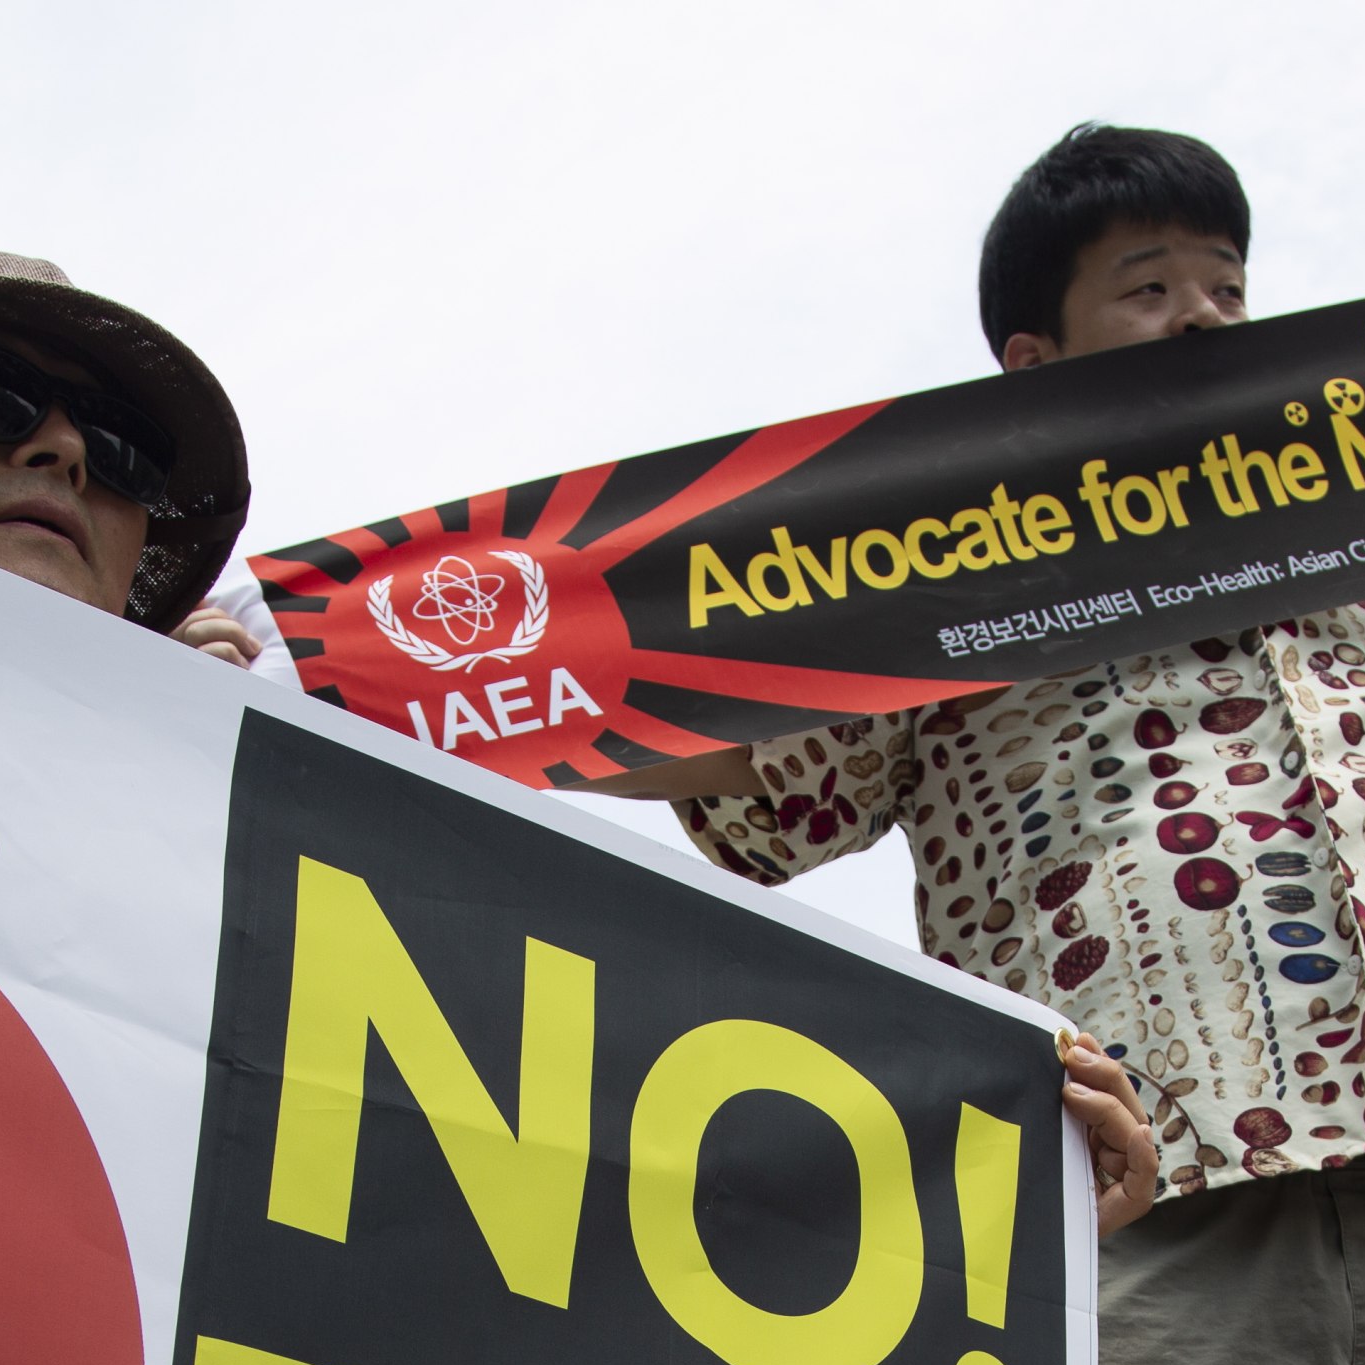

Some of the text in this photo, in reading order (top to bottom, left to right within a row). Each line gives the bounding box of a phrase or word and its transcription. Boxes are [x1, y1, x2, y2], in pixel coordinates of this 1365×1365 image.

[687, 482, 1075, 629] Advocate
[1078, 459, 1190, 542] for
[1199, 433, 1329, 518] the
[937, 588, 1142, 658] 환경보건시민센터
[1147, 561, 1286, 609] Eco-Health:
[1287, 548, 1349, 578] Asian
[406, 667, 603, 751] IAEA
